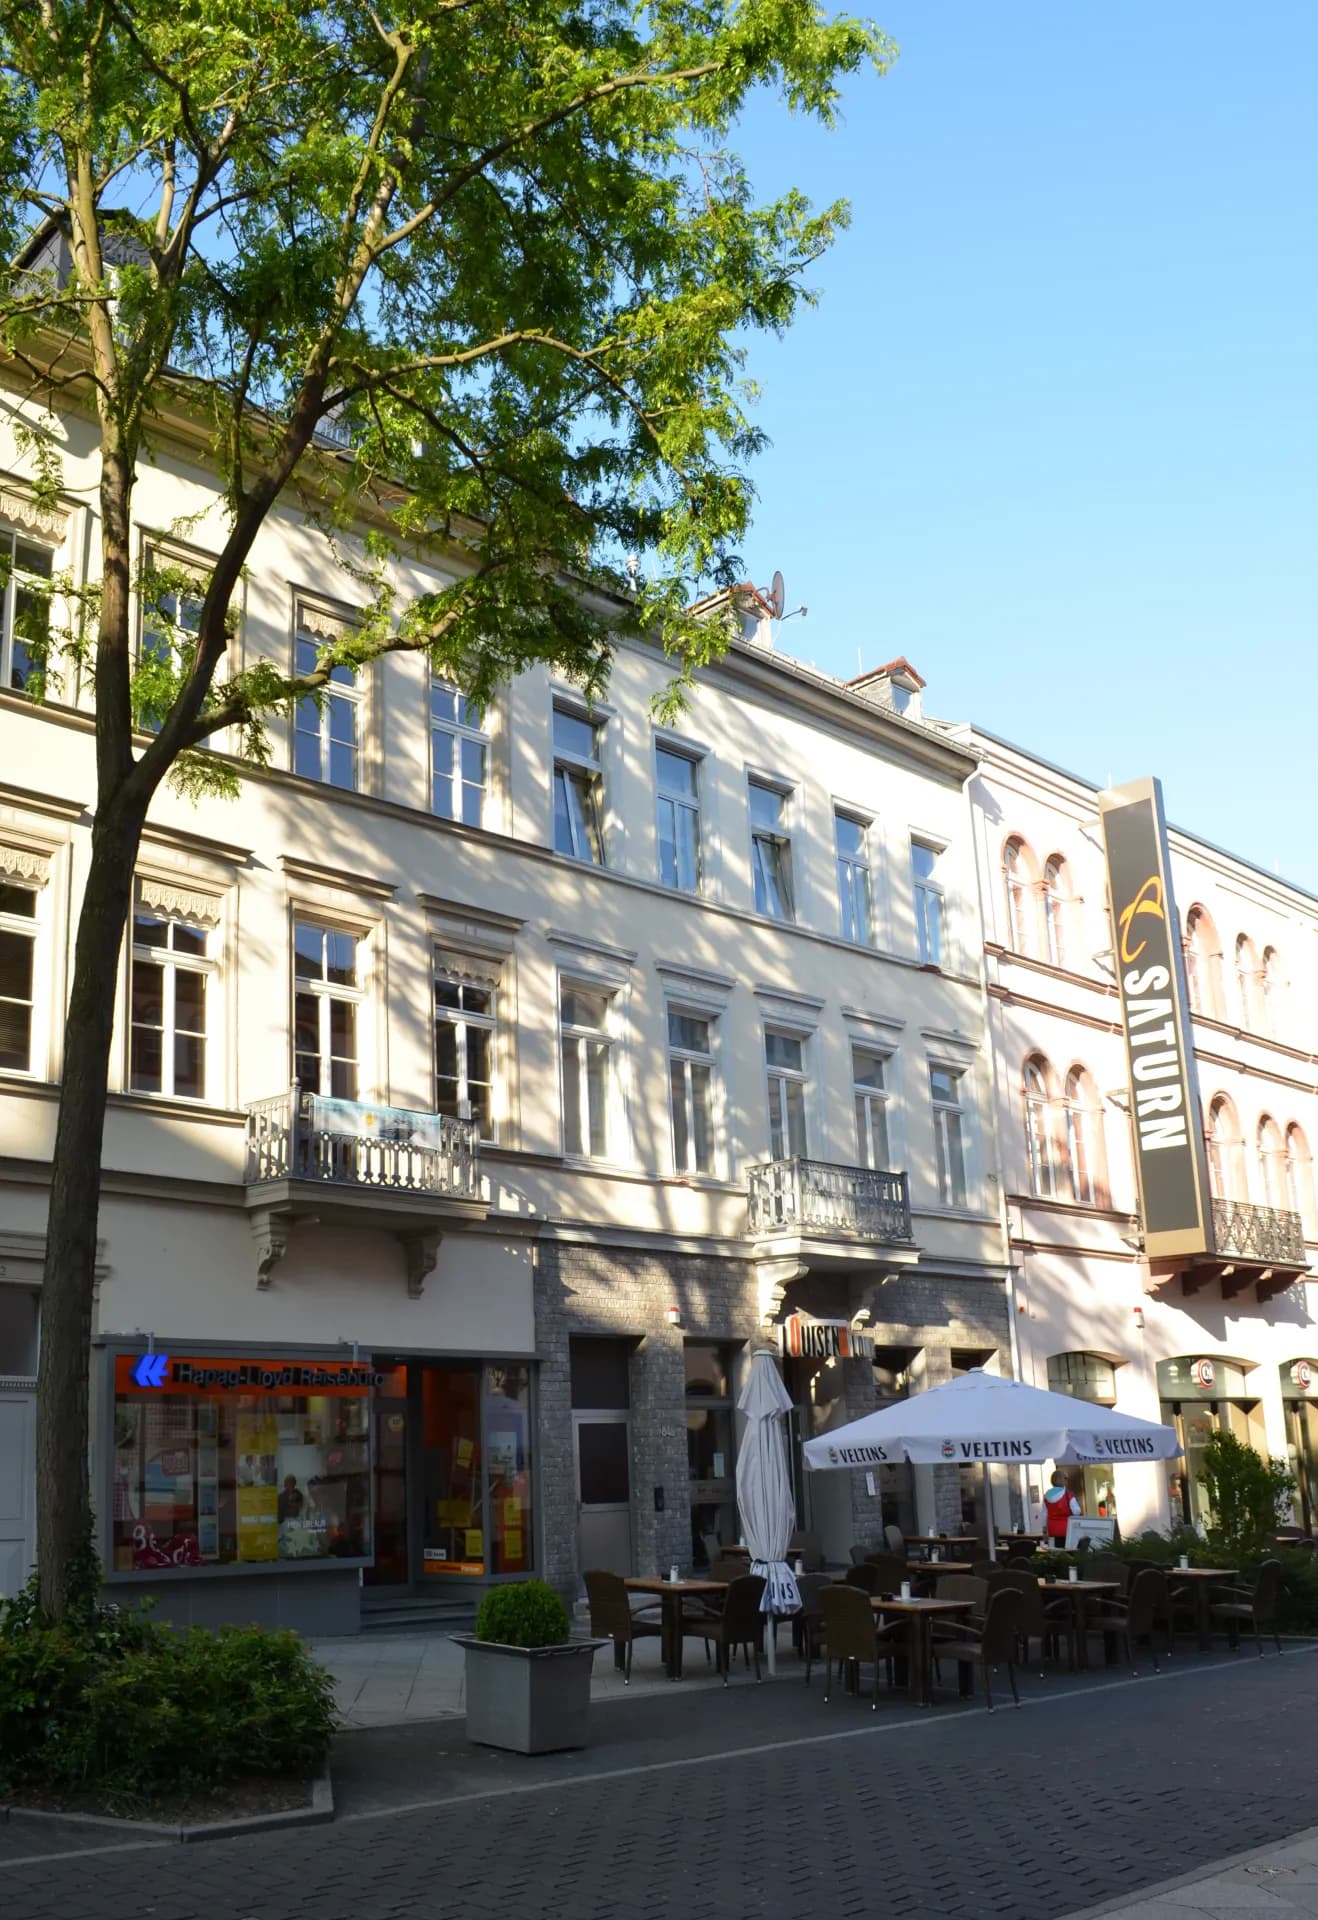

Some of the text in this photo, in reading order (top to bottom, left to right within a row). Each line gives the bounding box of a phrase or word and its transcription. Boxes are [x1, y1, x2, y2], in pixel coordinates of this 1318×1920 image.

[1124, 965, 1188, 1152] SATURN
[783, 1316, 841, 1358] LOUISEN
[174, 1362, 293, 1388] Hapag-Lloyd
[839, 1446, 888, 1464] VELTINS
[960, 1440, 1032, 1458] VELTINS
[1105, 1437, 1154, 1455] VELTINS
